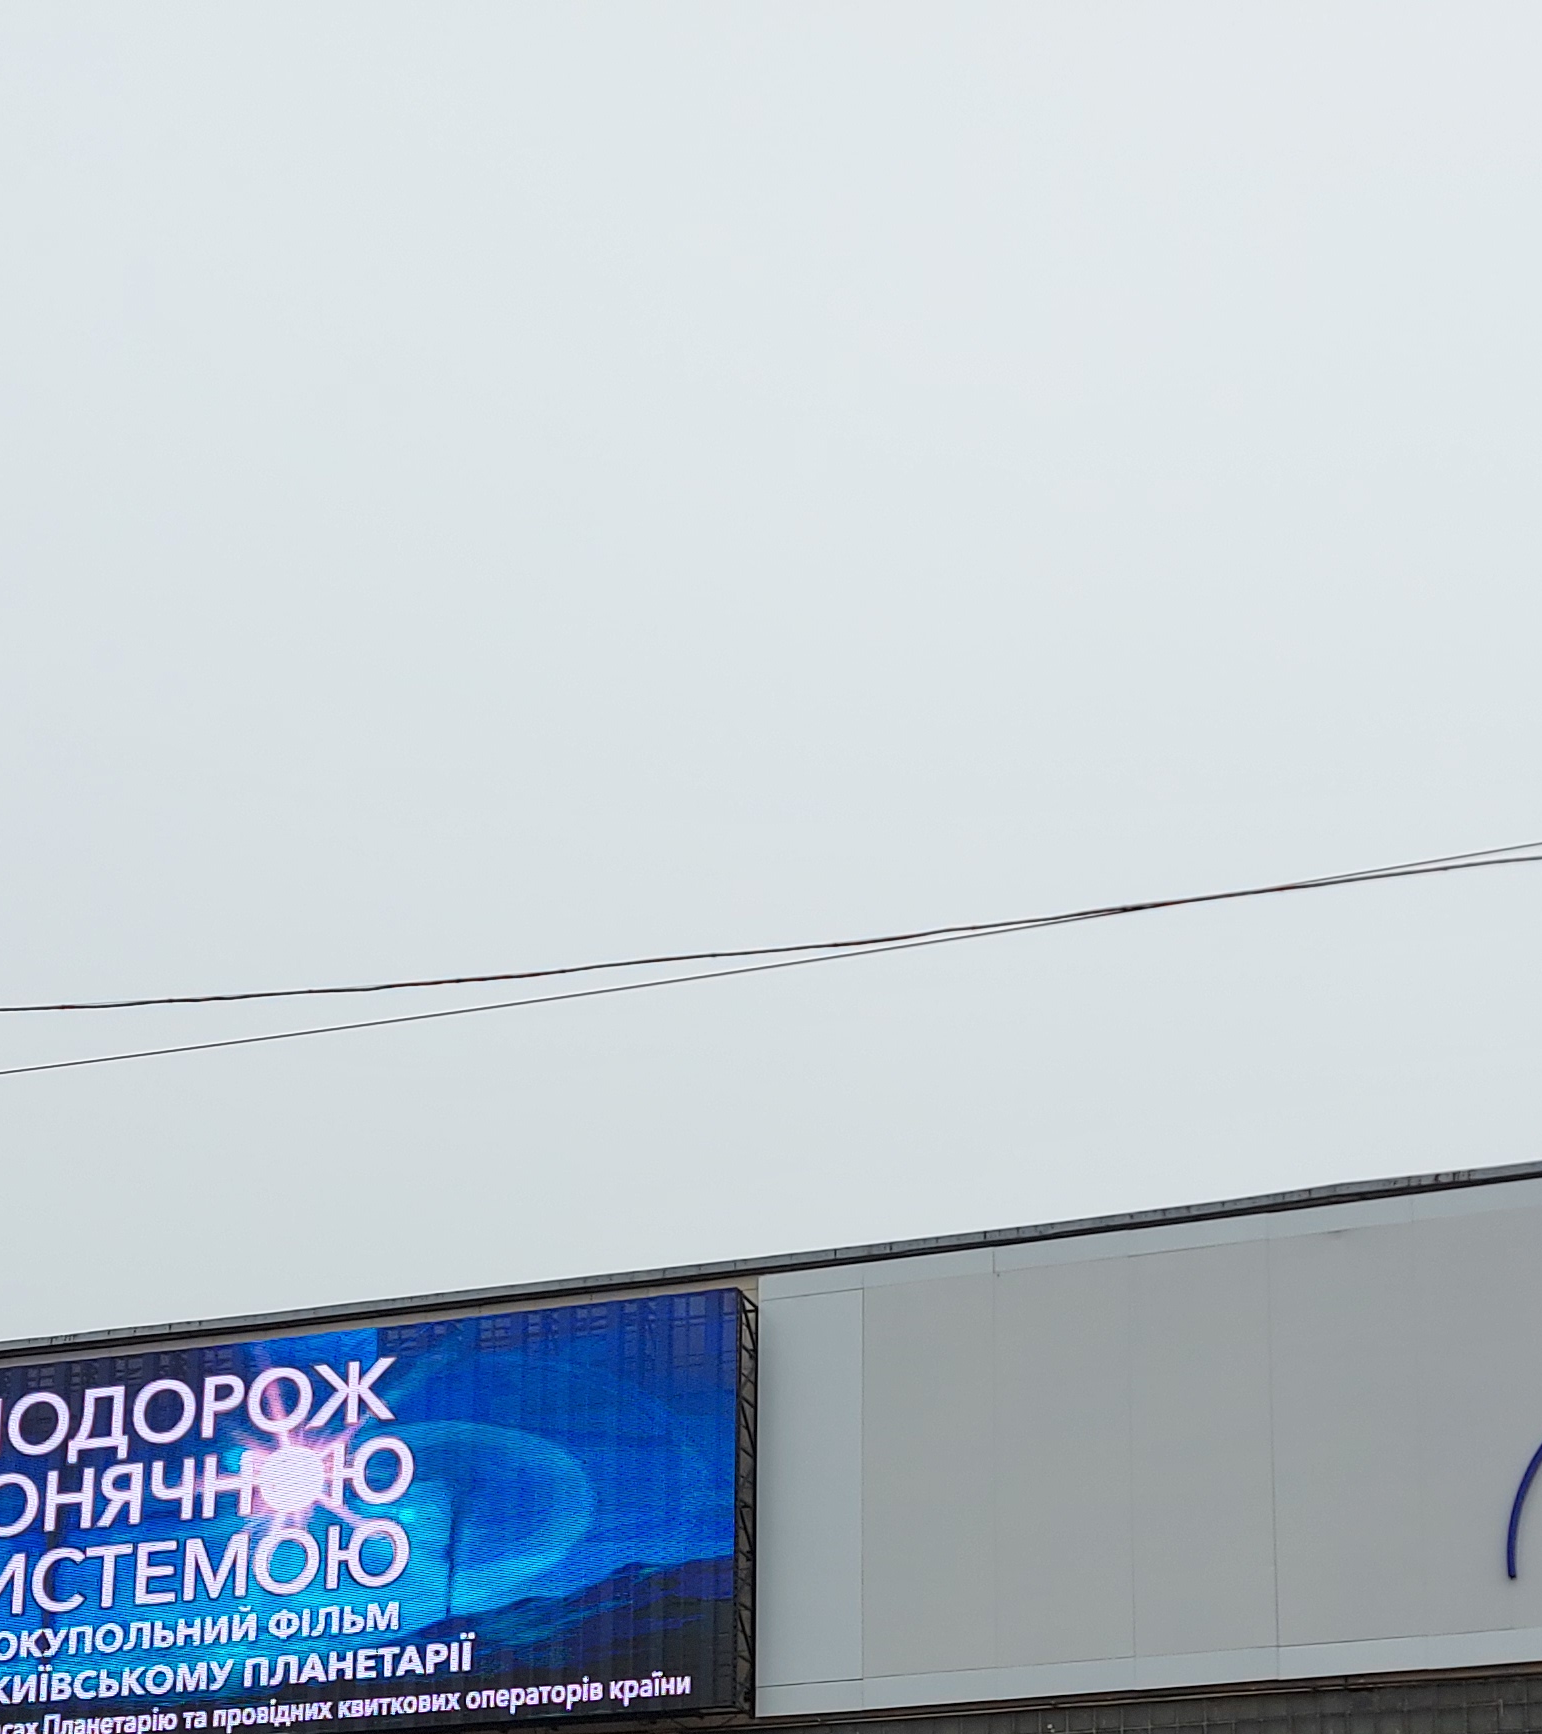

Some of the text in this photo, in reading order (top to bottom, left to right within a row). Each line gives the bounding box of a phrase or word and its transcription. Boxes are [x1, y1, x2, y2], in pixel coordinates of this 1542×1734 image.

[268, 1601, 400, 1639] ФІЛЬМ
[243, 1632, 476, 1688] ПЛАНЕТАРІЇ
[182, 1711, 208, 1730] та
[213, 1699, 333, 1733] провідних
[338, 1690, 462, 1720] квиткових
[465, 1675, 603, 1715] операторів
[609, 1671, 692, 1707] країни
